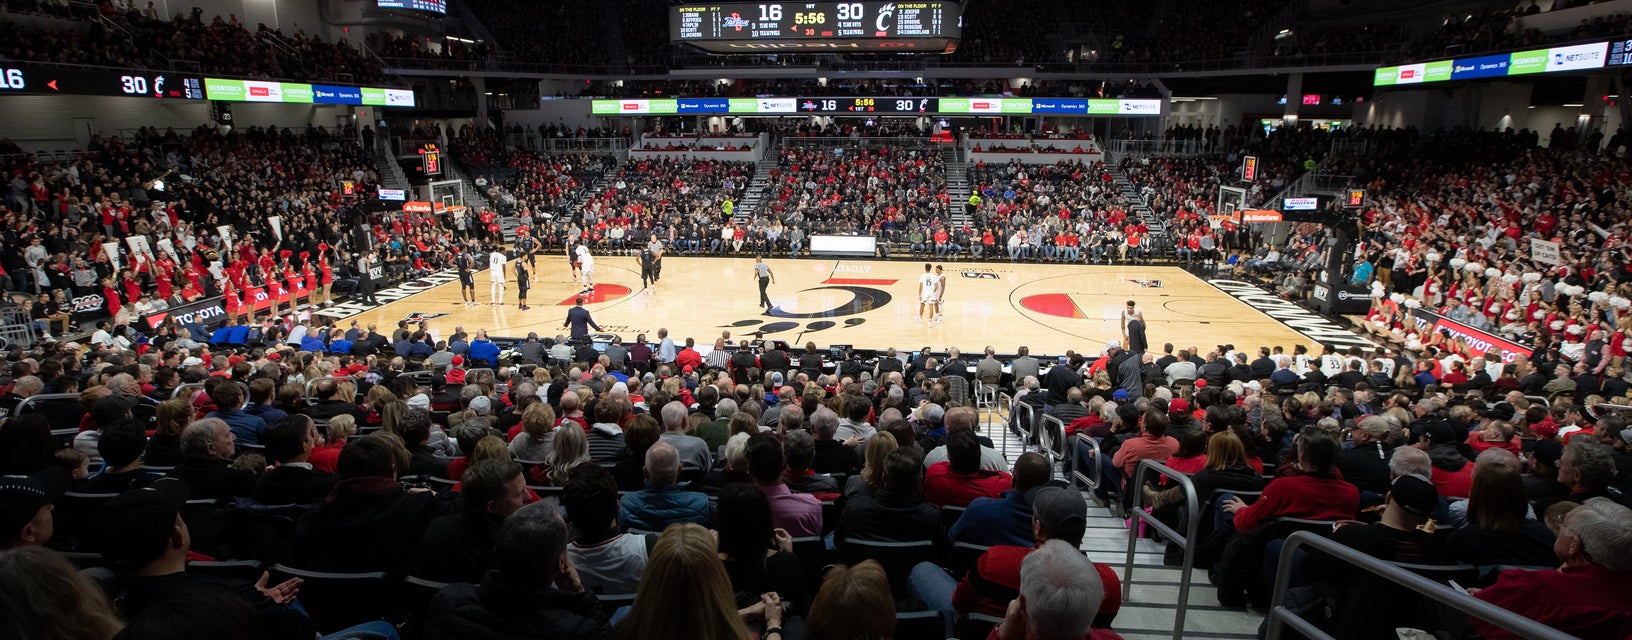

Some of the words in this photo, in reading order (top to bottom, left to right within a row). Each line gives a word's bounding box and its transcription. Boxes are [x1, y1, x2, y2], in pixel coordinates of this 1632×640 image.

[759, 4, 783, 21] 16
[837, 3, 864, 20] 30
[795, 12, 826, 25] 5:56
[1624, 40, 1632, 51] 3
[1565, 52, 1600, 62] NETSUITE
[0, 67, 25, 90] 16
[184, 78, 190, 88] 4
[121, 75, 148, 94] 30
[185, 88, 192, 99] 5
[821, 100, 837, 111] 16
[855, 98, 875, 106] 5:56
[896, 100, 913, 111] 30
[1350, 197, 1361, 205] 30
[1329, 359, 1341, 370] 33
